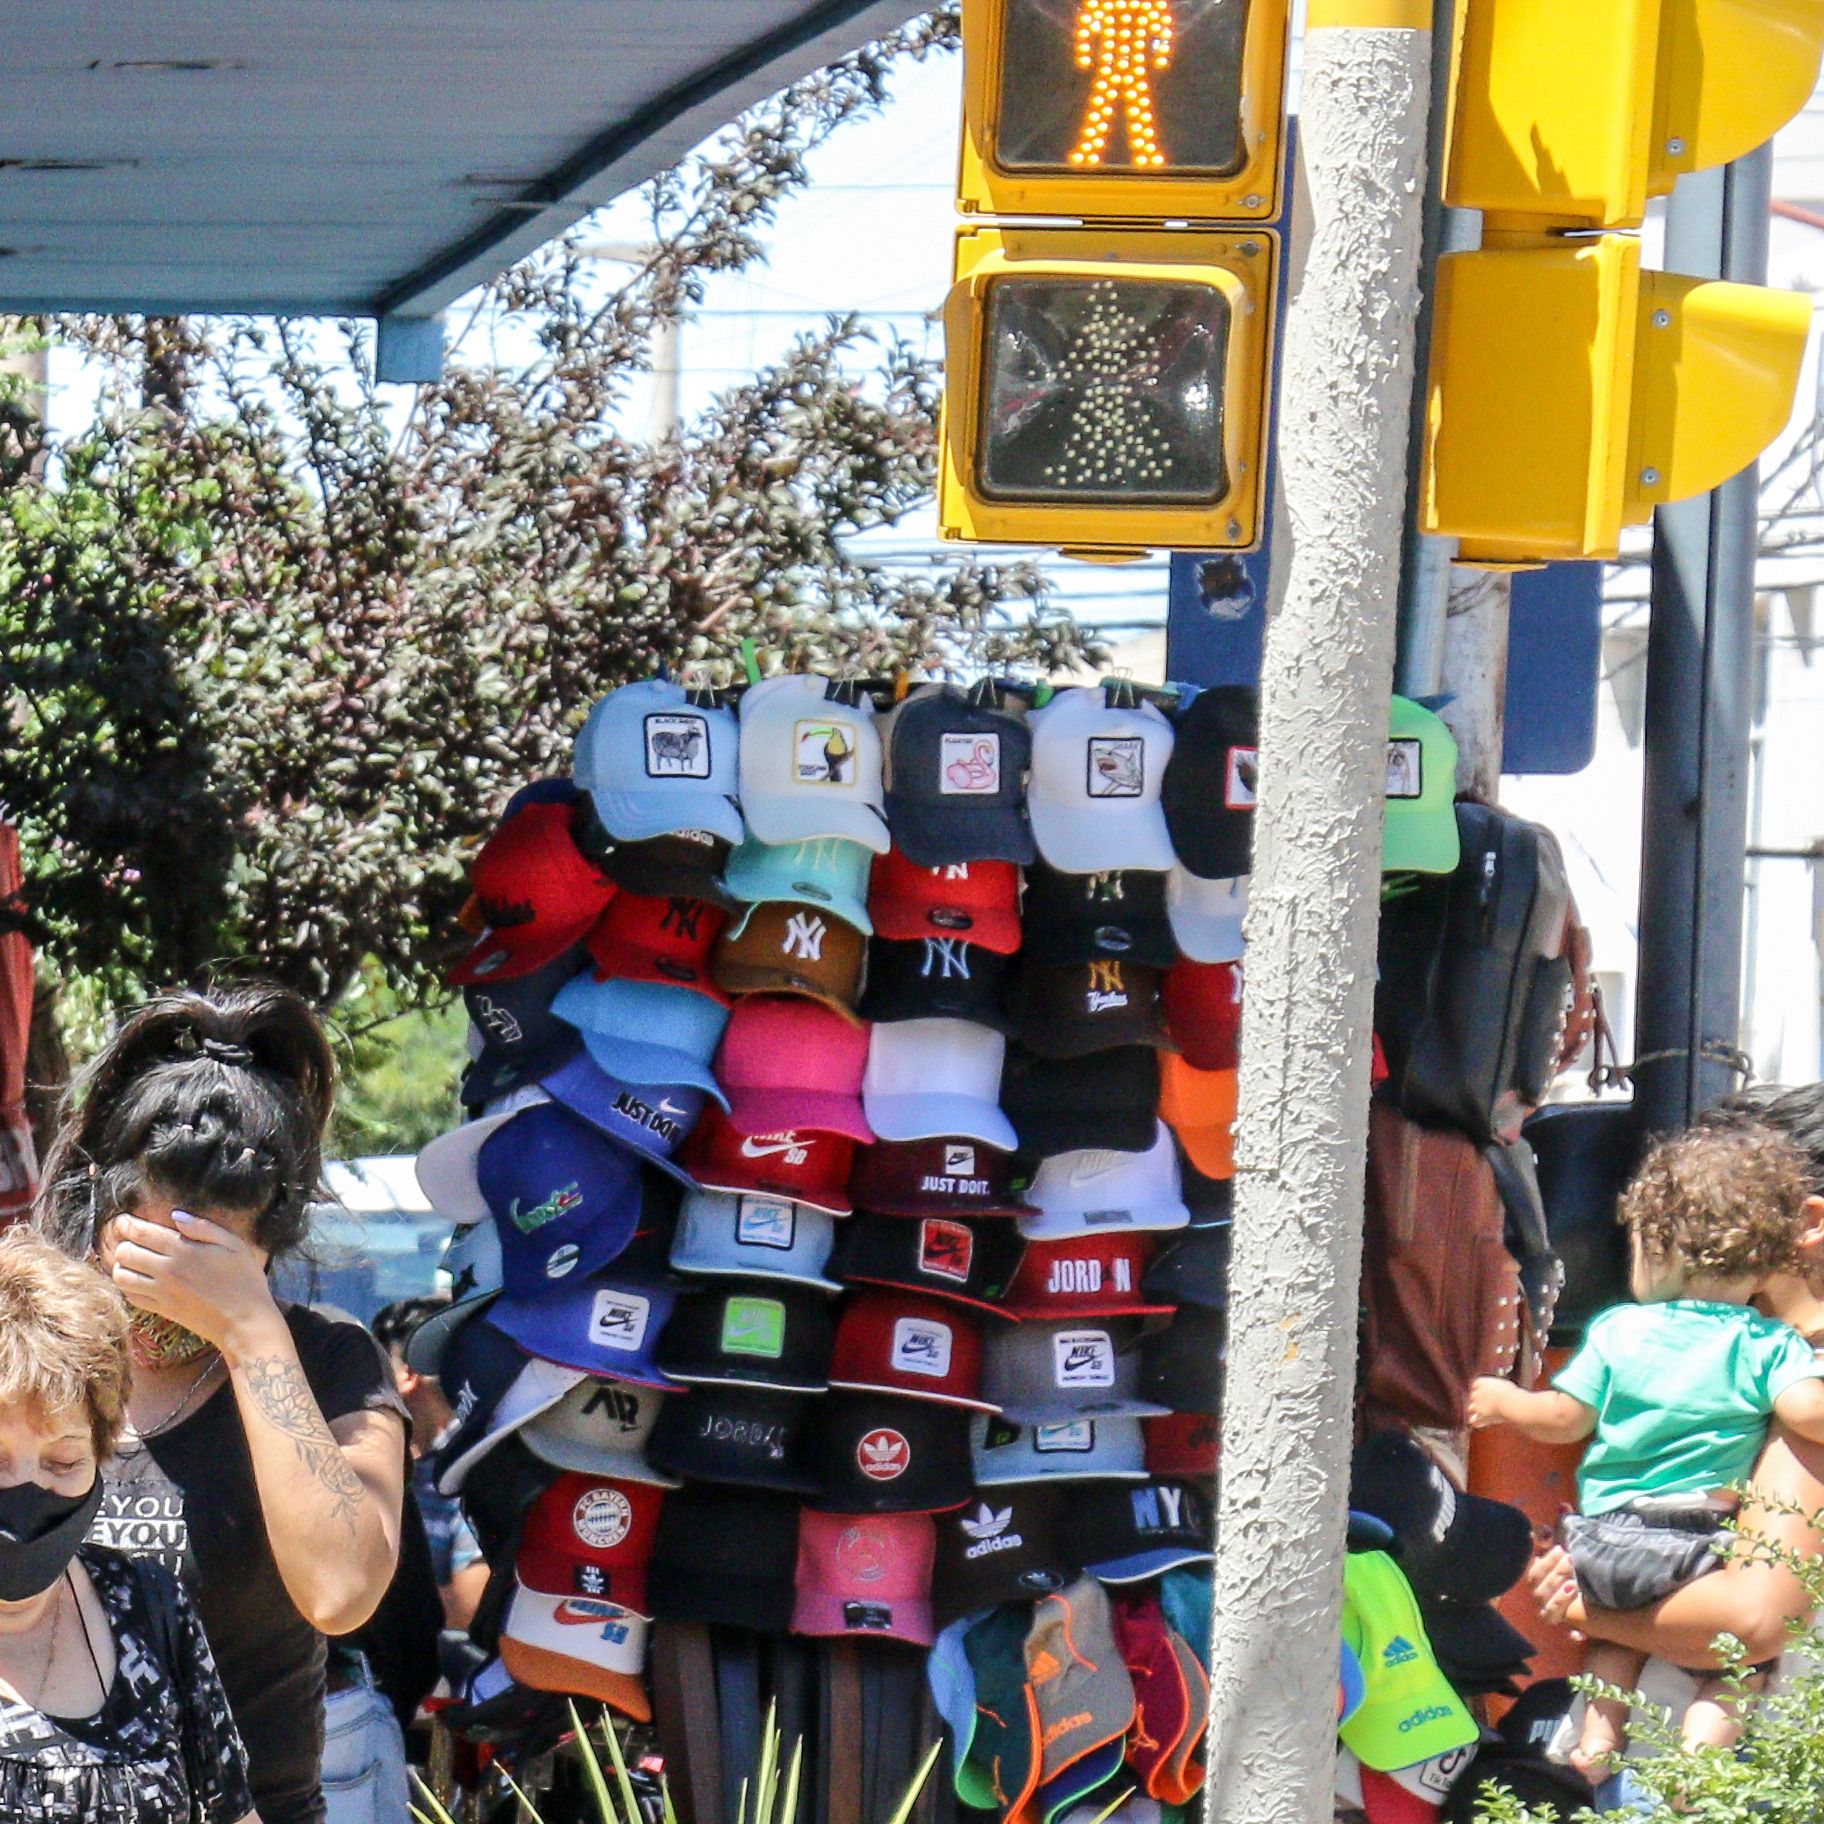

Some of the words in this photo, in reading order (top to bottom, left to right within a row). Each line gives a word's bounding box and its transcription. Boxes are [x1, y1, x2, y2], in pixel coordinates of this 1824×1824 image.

[782, 911, 827, 961] NY
[921, 1176, 955, 1193] JUST
[1071, 1345, 1098, 1358] NIKE
[964, 1533, 1024, 1560] adidas
[1398, 1704, 1454, 1733] adidas
